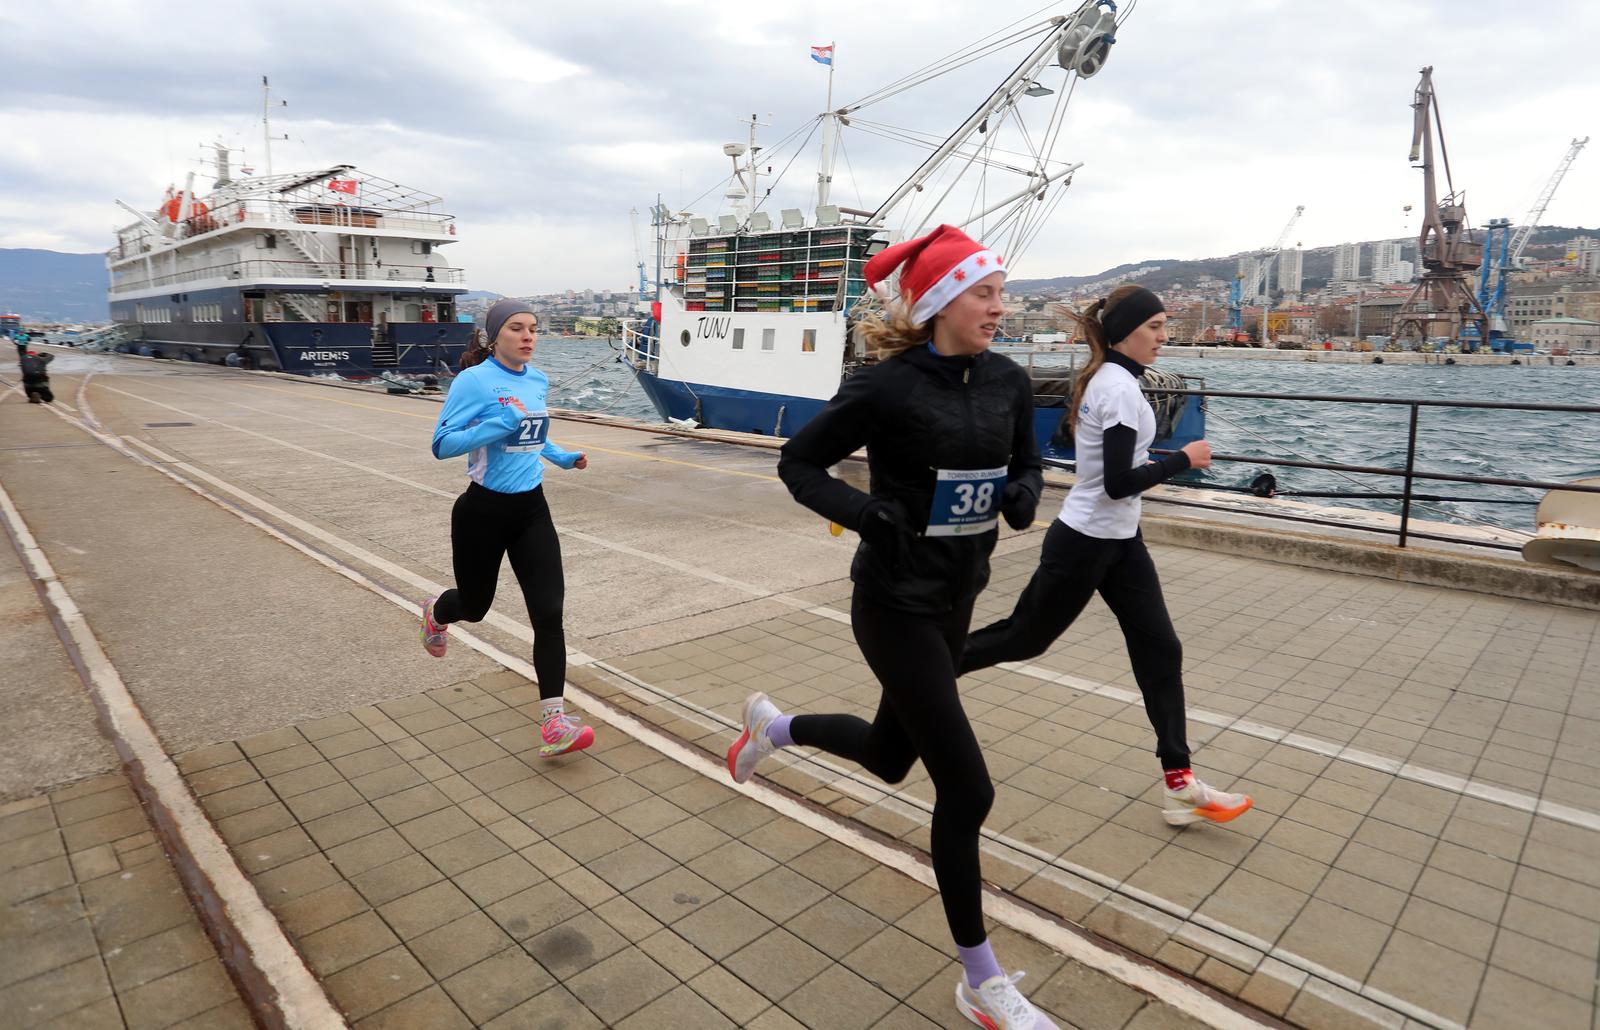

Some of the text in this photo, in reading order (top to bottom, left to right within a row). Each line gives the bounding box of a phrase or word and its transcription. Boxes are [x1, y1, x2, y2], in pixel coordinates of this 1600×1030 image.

[697, 316, 731, 339] TUNJ
[299, 351, 350, 361] ARTEMIS
[519, 419, 543, 440] 27
[950, 481, 995, 515] 38
